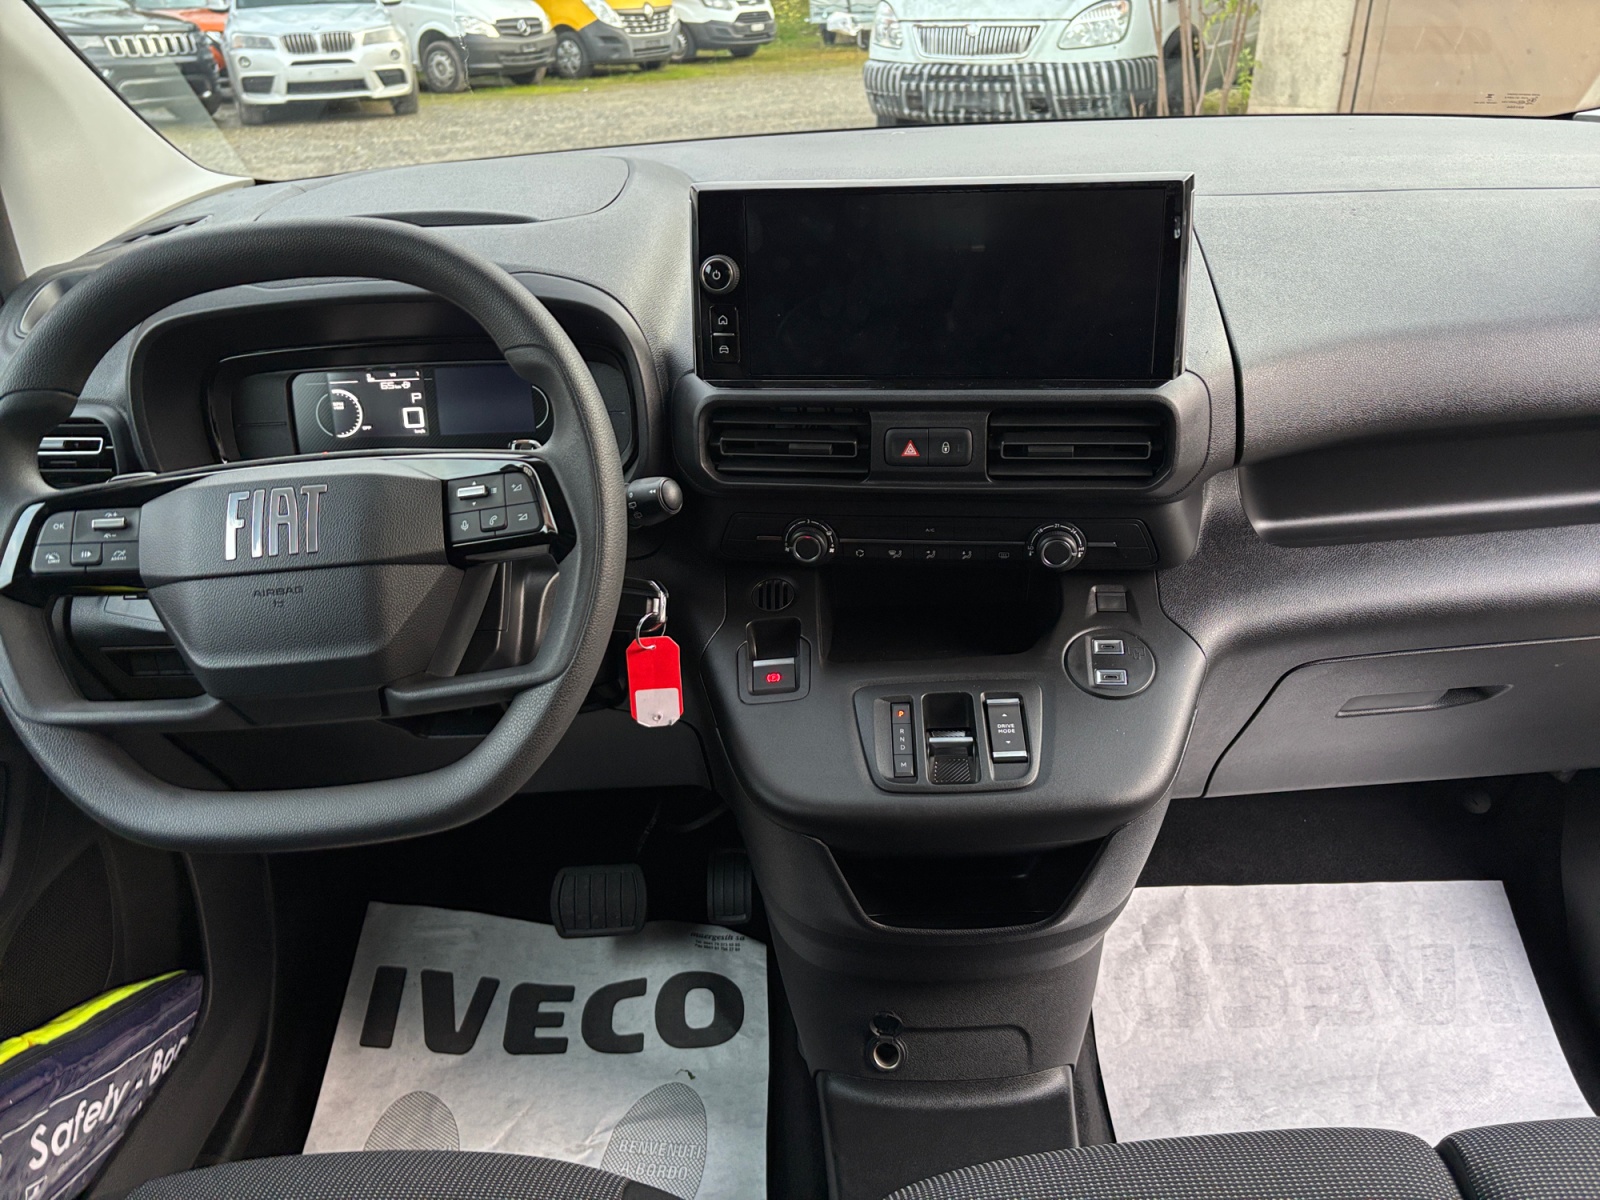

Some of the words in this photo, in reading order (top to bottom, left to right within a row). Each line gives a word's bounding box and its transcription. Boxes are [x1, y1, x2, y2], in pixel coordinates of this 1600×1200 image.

[410, 392, 422, 404] P
[402, 406, 425, 429] 0
[53, 522, 64, 530] OK
[225, 484, 328, 561] FIAT
[253, 585, 304, 597] AIRBAG
[359, 965, 745, 1056] IVECO
[29, 1080, 130, 1171] Safety
[618, 1139, 702, 1159] BENVENUTI
[620, 1160, 630, 1174] A
[635, 1162, 688, 1181] BORDO
